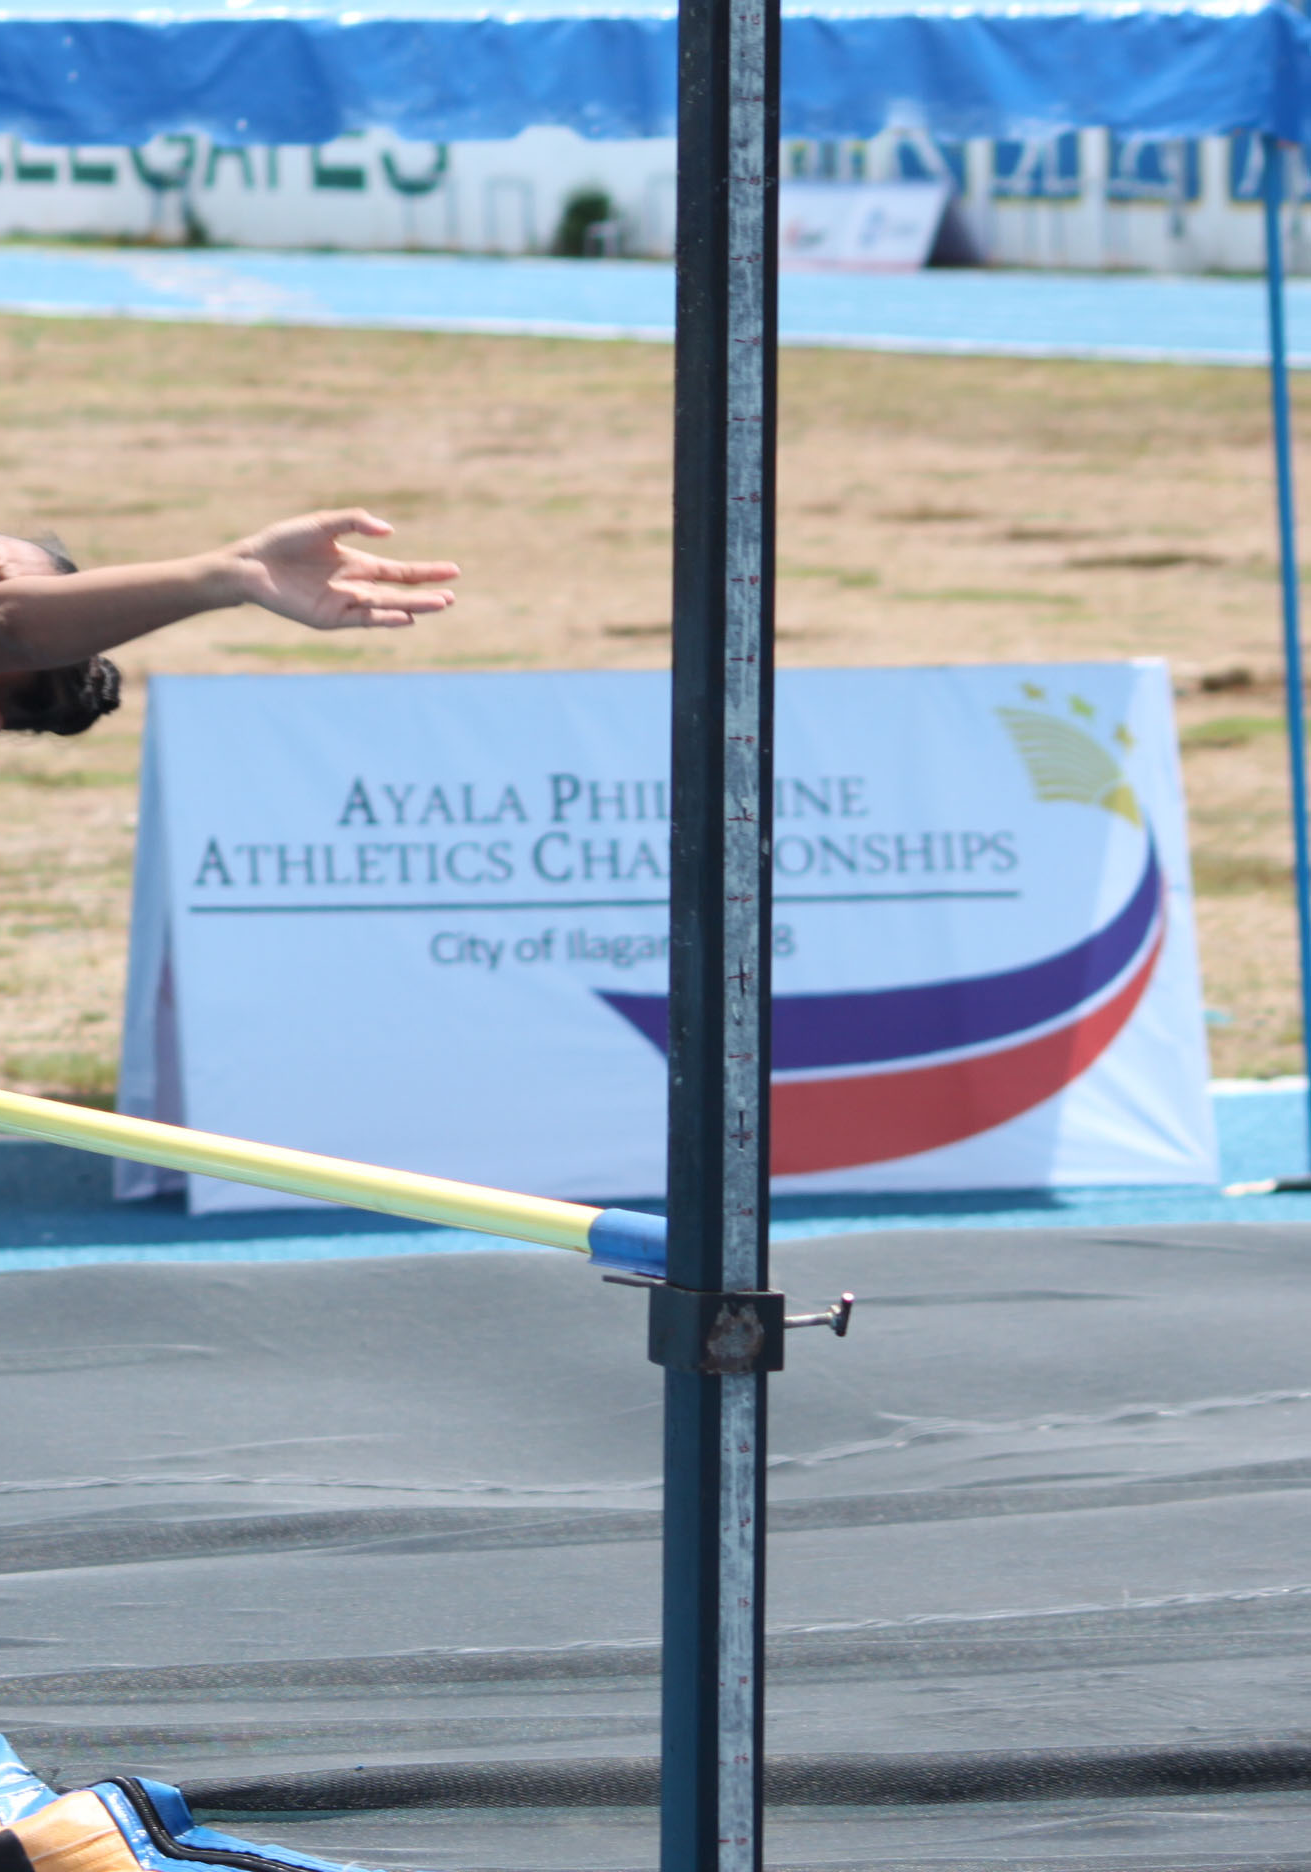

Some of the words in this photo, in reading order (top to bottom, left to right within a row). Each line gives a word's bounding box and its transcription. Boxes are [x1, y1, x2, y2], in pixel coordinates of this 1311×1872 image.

[338, 776, 529, 827] AYALA
[548, 773, 870, 825] PHILINE
[193, 837, 514, 887] ATHLETICS
[531, 830, 1021, 883] CHAONSHIPS
[429, 931, 505, 969] City
[514, 930, 557, 963] of
